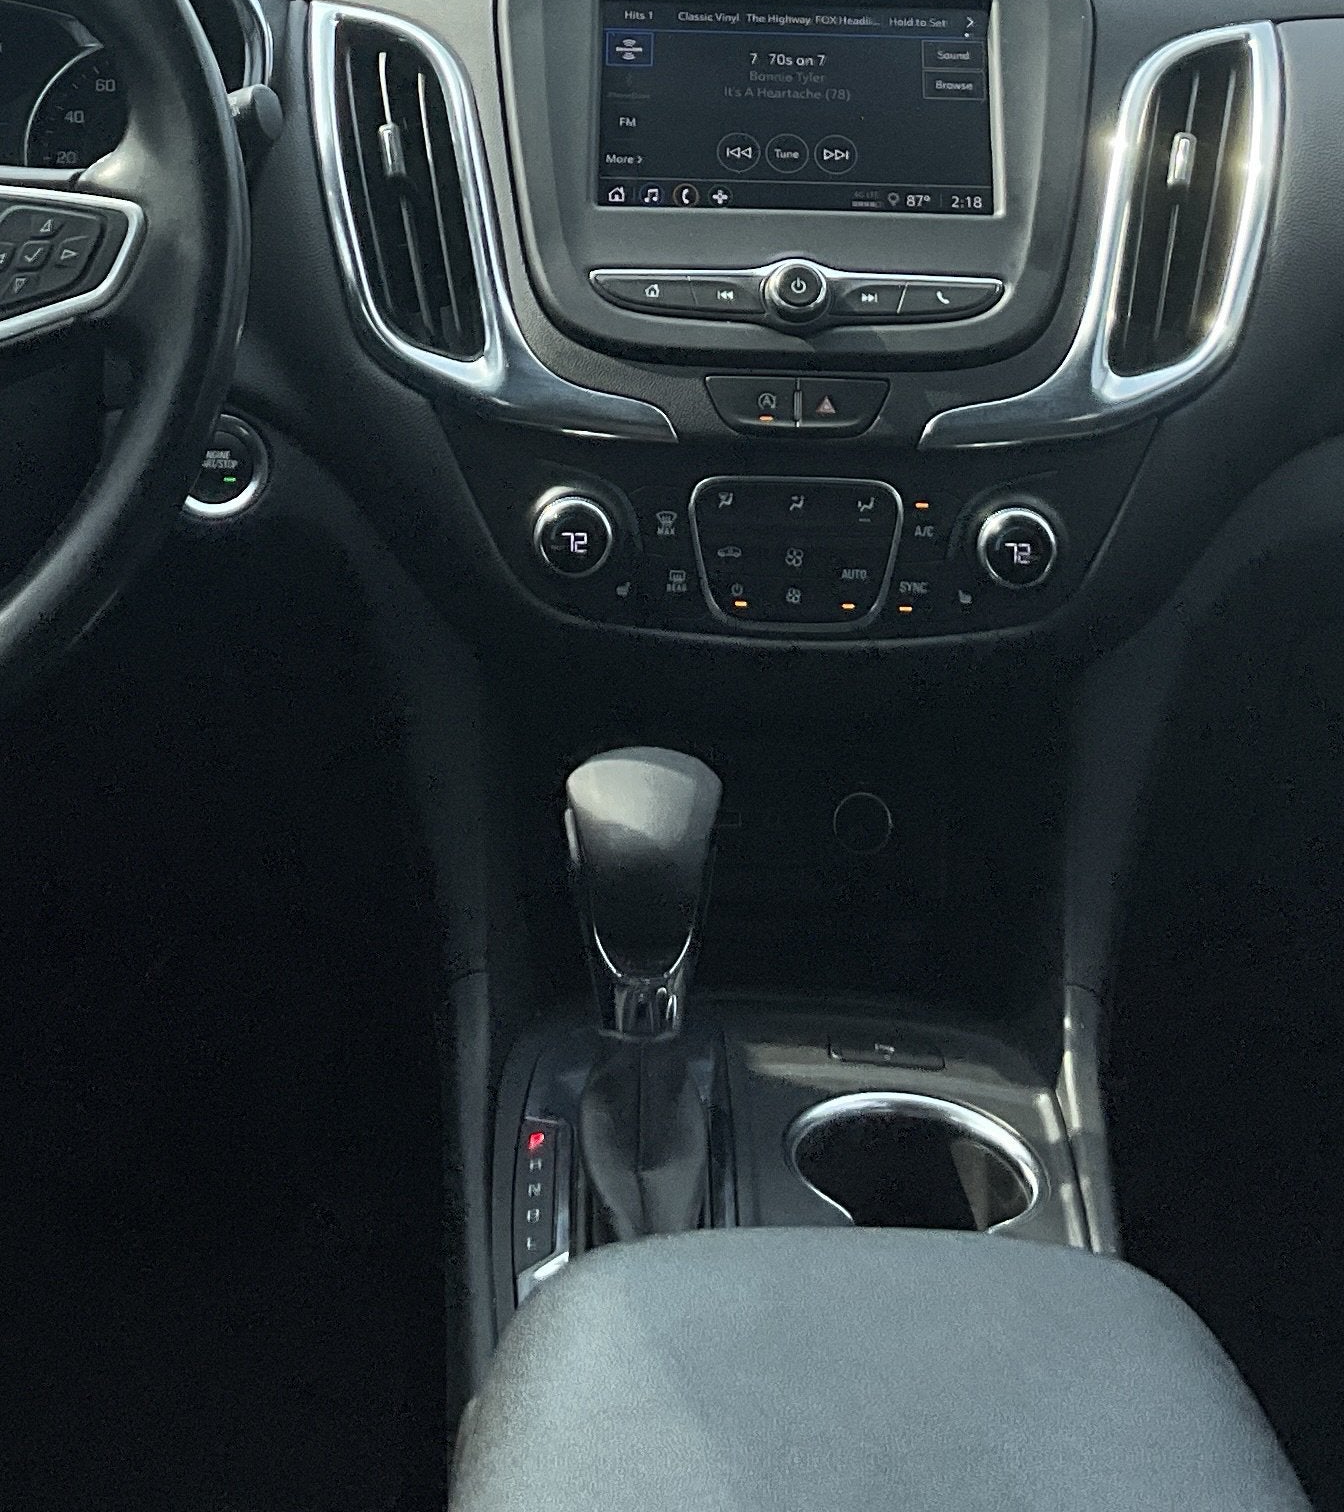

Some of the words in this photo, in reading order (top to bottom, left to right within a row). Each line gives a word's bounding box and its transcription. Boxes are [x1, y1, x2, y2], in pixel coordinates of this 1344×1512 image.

[624, 10, 646, 20] Hits
[678, 11, 713, 22] Classic
[715, 12, 740, 24] Vinyl
[746, 13, 767, 23] The
[768, 14, 811, 26] Highway
[815, 15, 837, 25] FOX
[889, 17, 914, 27] Hold
[916, 19, 927, 27] to
[929, 18, 947, 28] Set
[750, 53, 758, 65] 7
[768, 53, 793, 66] 70s
[796, 56, 814, 66] on
[817, 54, 826, 67] 7
[937, 51, 970, 60] Sound
[796, 72, 825, 84] Tyler
[95, 78, 116, 93] 60
[935, 80, 973, 90] Browse
[744, 87, 754, 97] A
[757, 87, 822, 100] Heartache
[825, 88, 852, 102] (78)
[64, 109, 85, 124] 40
[619, 116, 637, 127] FM
[56, 150, 78, 165] 20
[606, 154, 634, 164] More
[774, 148, 800, 159] Tune
[951, 195, 983, 209] 2:18
[914, 525, 934, 537] A/C
[561, 531, 588, 553] 72
[1005, 542, 1032, 565] 72
[841, 568, 868, 580] AUTO
[528, 1132, 545, 1150] P
